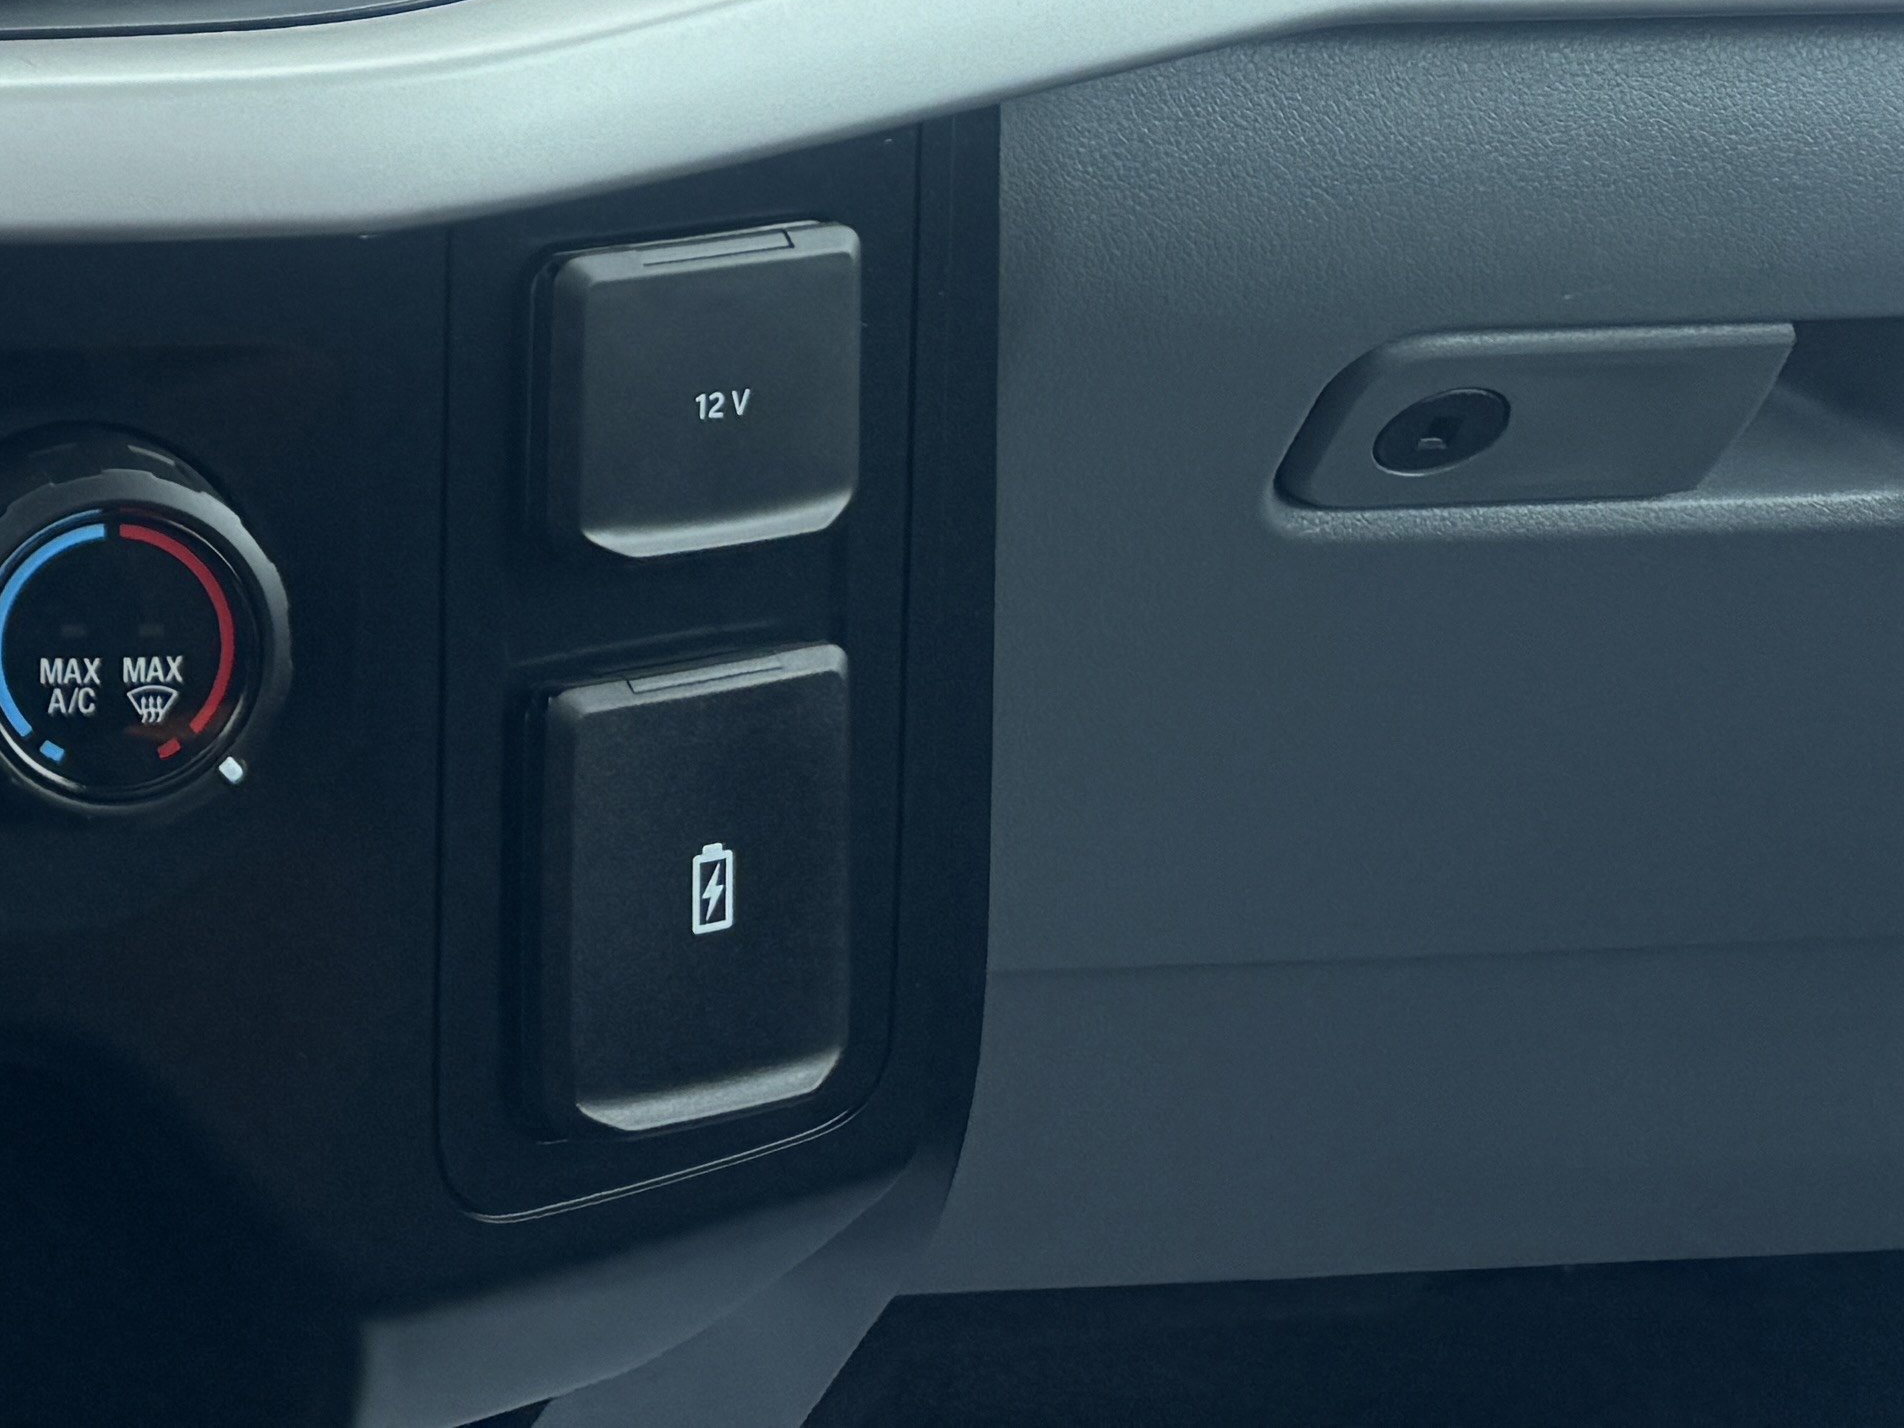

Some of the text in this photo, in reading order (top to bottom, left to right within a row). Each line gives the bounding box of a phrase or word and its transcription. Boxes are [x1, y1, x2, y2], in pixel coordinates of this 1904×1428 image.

[695, 388, 751, 420] 12 V
[39, 658, 101, 685] MAX
[122, 656, 184, 683] MAX
[48, 687, 96, 714] A/C
